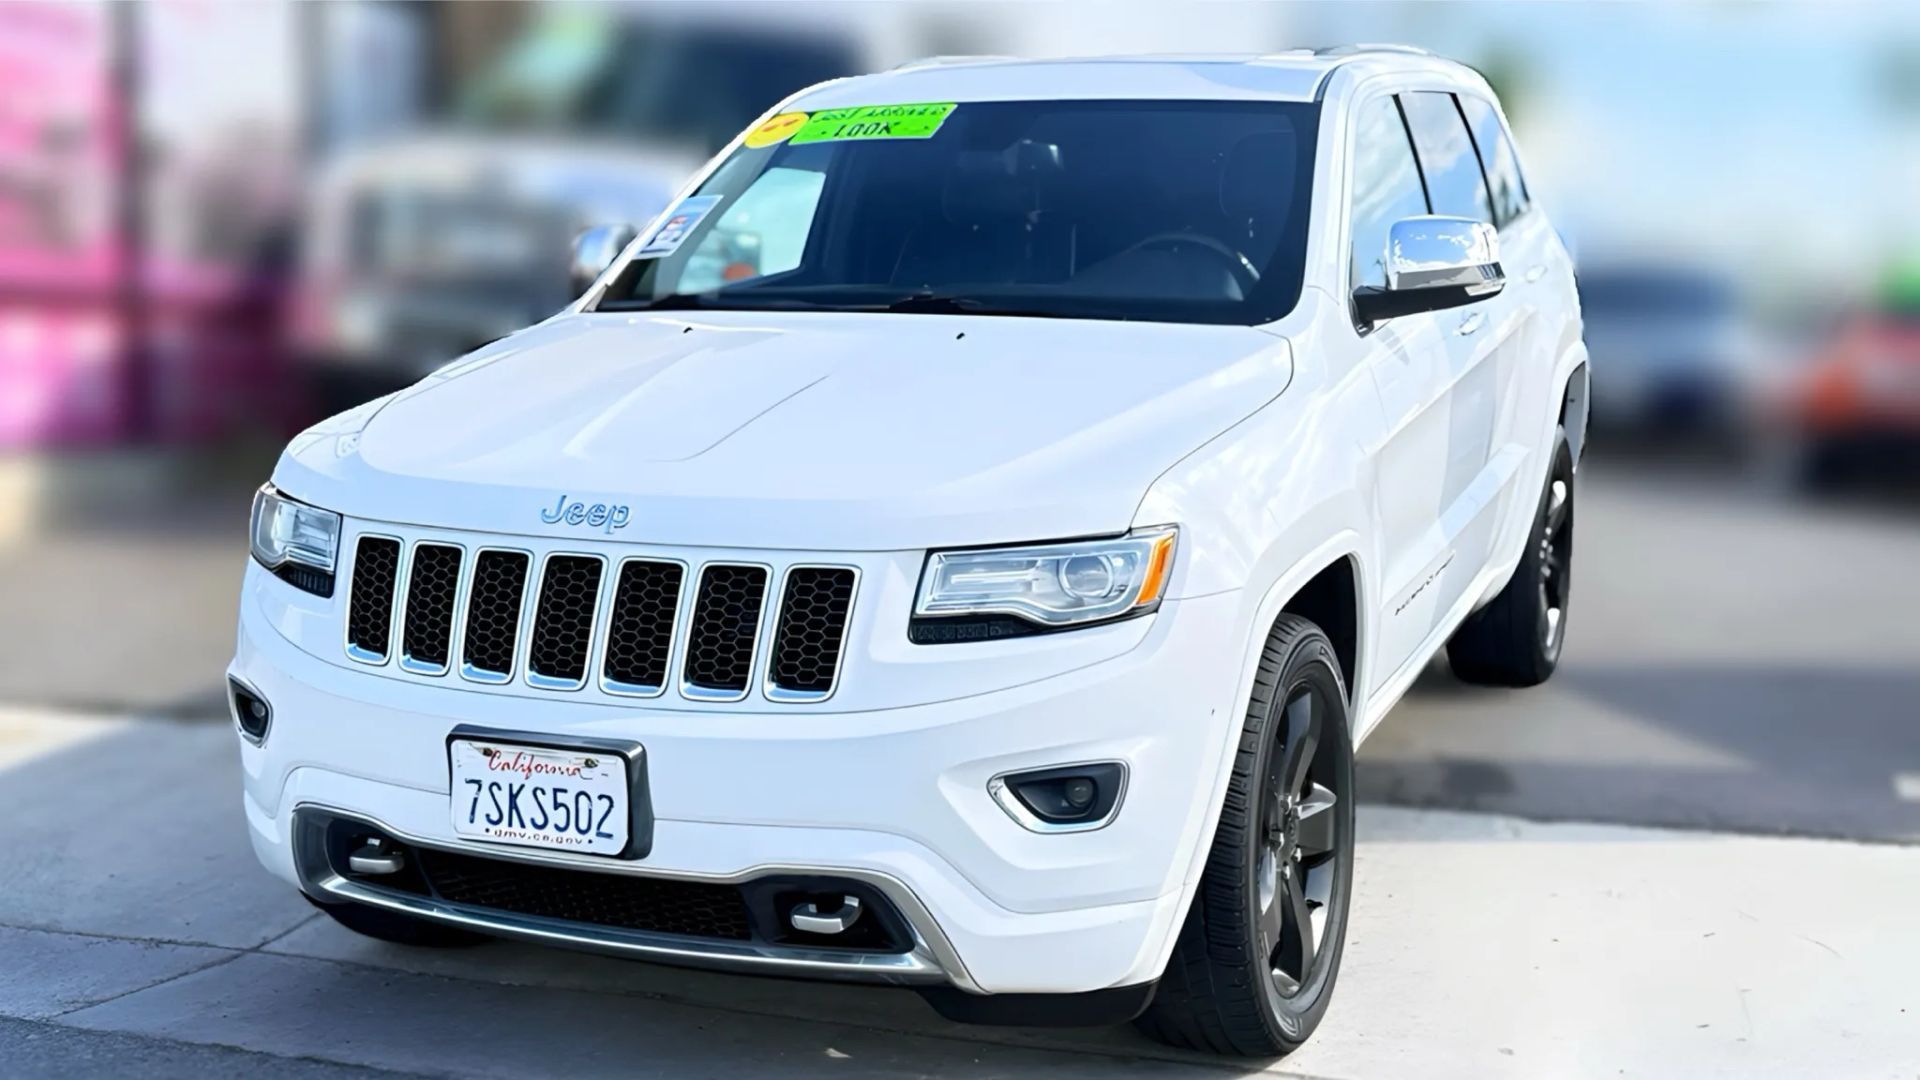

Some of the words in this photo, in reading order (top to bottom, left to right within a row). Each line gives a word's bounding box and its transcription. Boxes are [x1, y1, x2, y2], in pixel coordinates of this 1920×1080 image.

[541, 495, 631, 535] Jeep
[489, 750, 593, 780] California
[465, 779, 614, 840] 7SKS502
